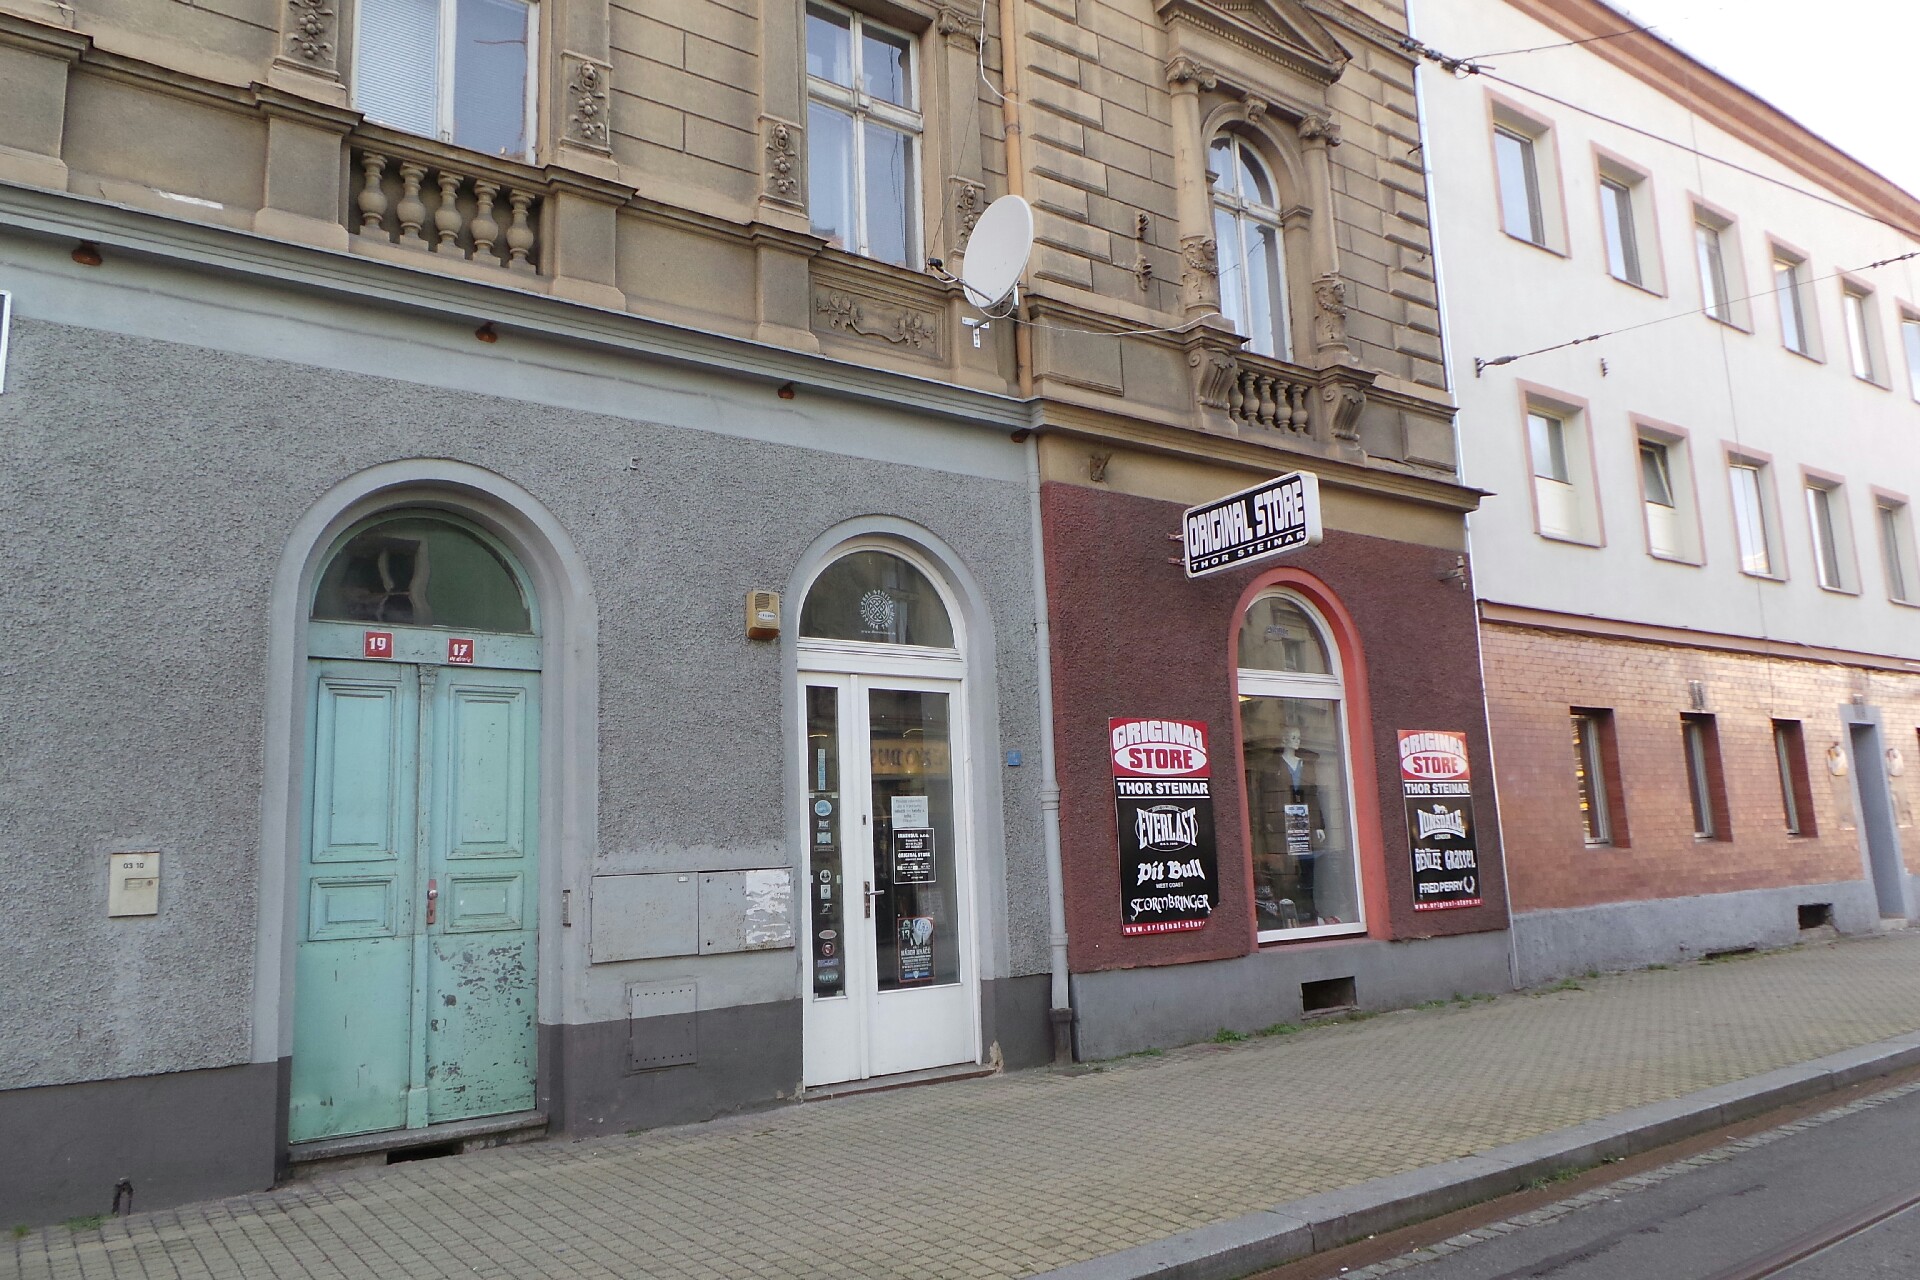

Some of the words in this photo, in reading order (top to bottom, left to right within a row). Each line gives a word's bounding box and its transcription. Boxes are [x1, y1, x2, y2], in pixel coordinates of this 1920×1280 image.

[1188, 500, 1253, 557] ORIGINAL
[1253, 480, 1304, 538] STORE
[1191, 554, 1229, 571] THOR
[1237, 531, 1305, 557] STEINAR
[369, 638, 386, 650] 19
[453, 644, 468, 655] 17
[1113, 720, 1206, 754] ORIGINAL
[1400, 733, 1466, 760] ORIGINAL
[1128, 748, 1193, 769] STORE
[1412, 756, 1459, 774] STORE
[1117, 781, 1153, 795] THOR
[1156, 782, 1209, 795] STEINAR
[1404, 783, 1431, 794] THOR
[1432, 783, 1470, 794] STEINAR
[1137, 807, 1197, 849] EVERLAST
[1417, 808, 1465, 839] LONSDALE
[1137, 861, 1164, 886] Pit
[1166, 858, 1206, 881] Bull
[1415, 852, 1443, 873] BENLEE
[1419, 883, 1439, 894] FRED
[1439, 880, 1463, 892] PERRY
[1131, 894, 1212, 921] STORMBRINGER
